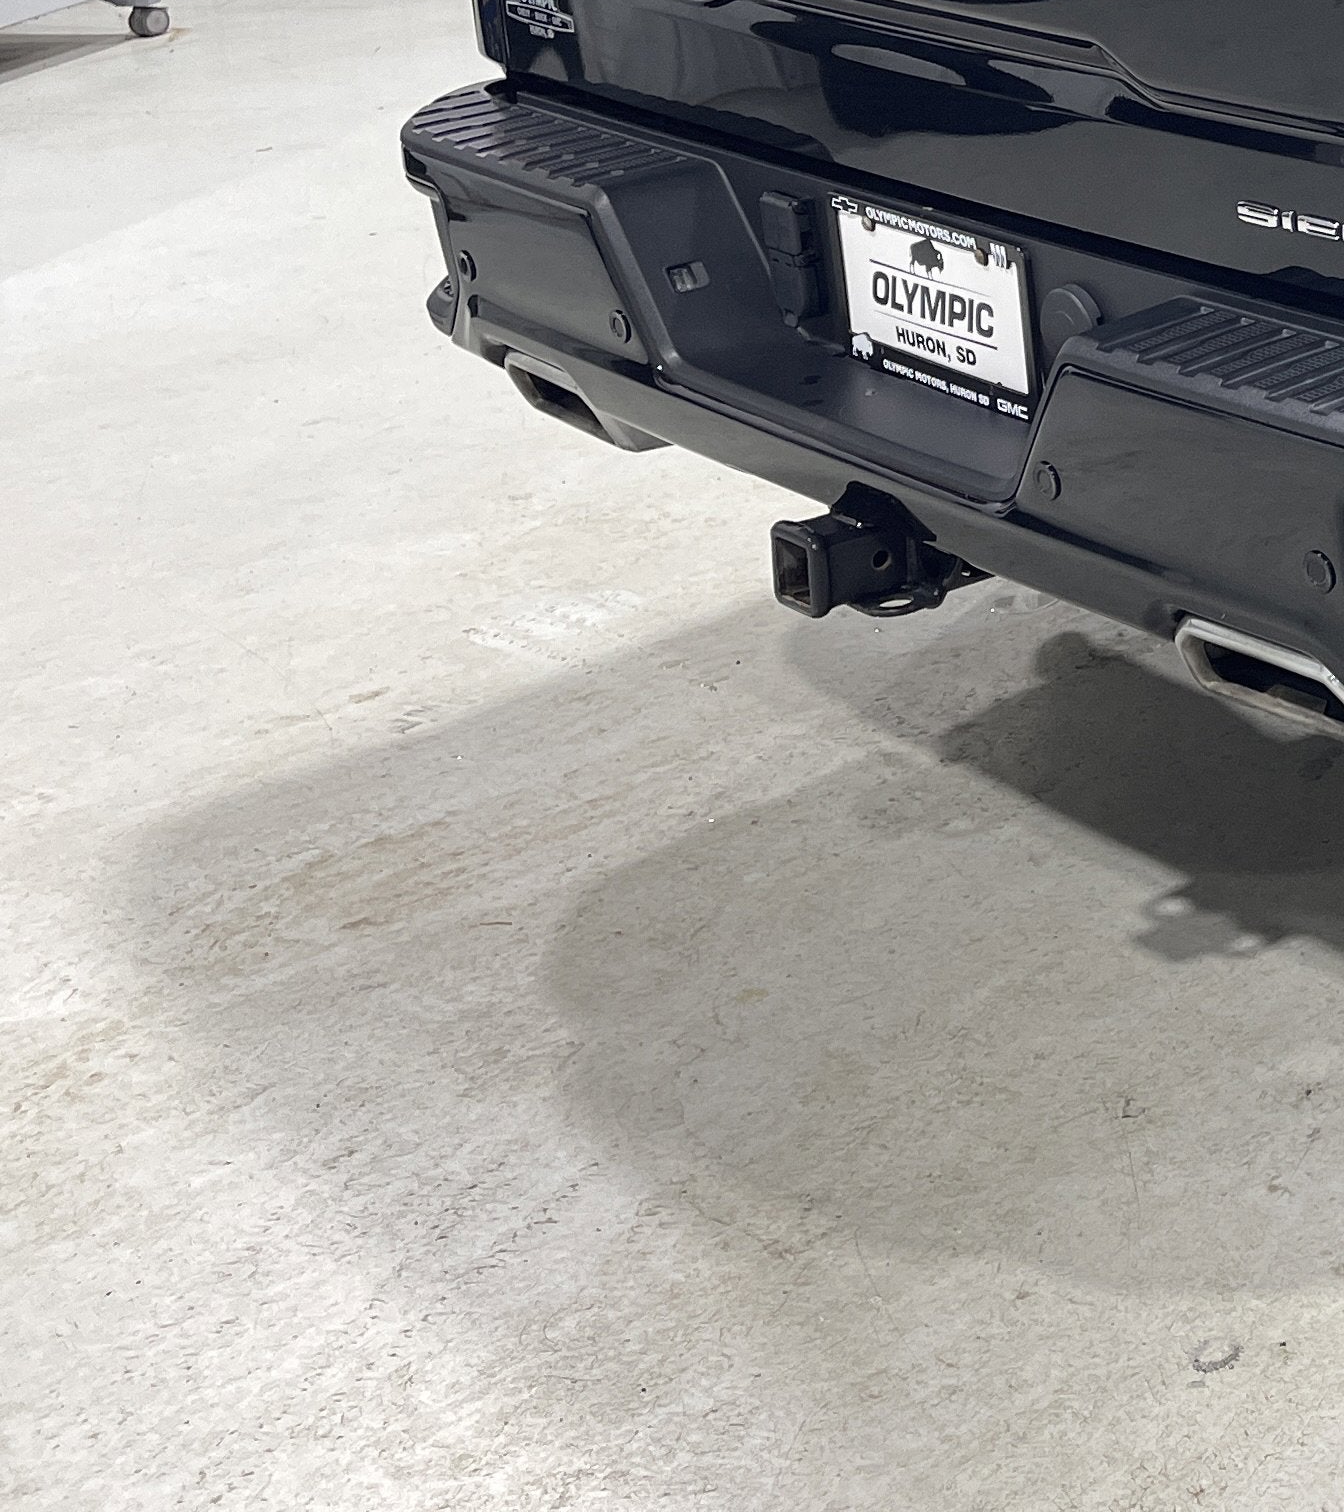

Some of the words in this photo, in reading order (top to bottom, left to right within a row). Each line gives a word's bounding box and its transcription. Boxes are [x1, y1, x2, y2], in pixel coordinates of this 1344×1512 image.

[865, 206, 977, 250] OLYMPICMOTORS.COM
[872, 271, 994, 338] OLYMPIC
[895, 326, 951, 362] HURON,
[956, 346, 977, 365] SD
[883, 358, 914, 379] OLYMPIC
[996, 398, 1029, 419] GMC
